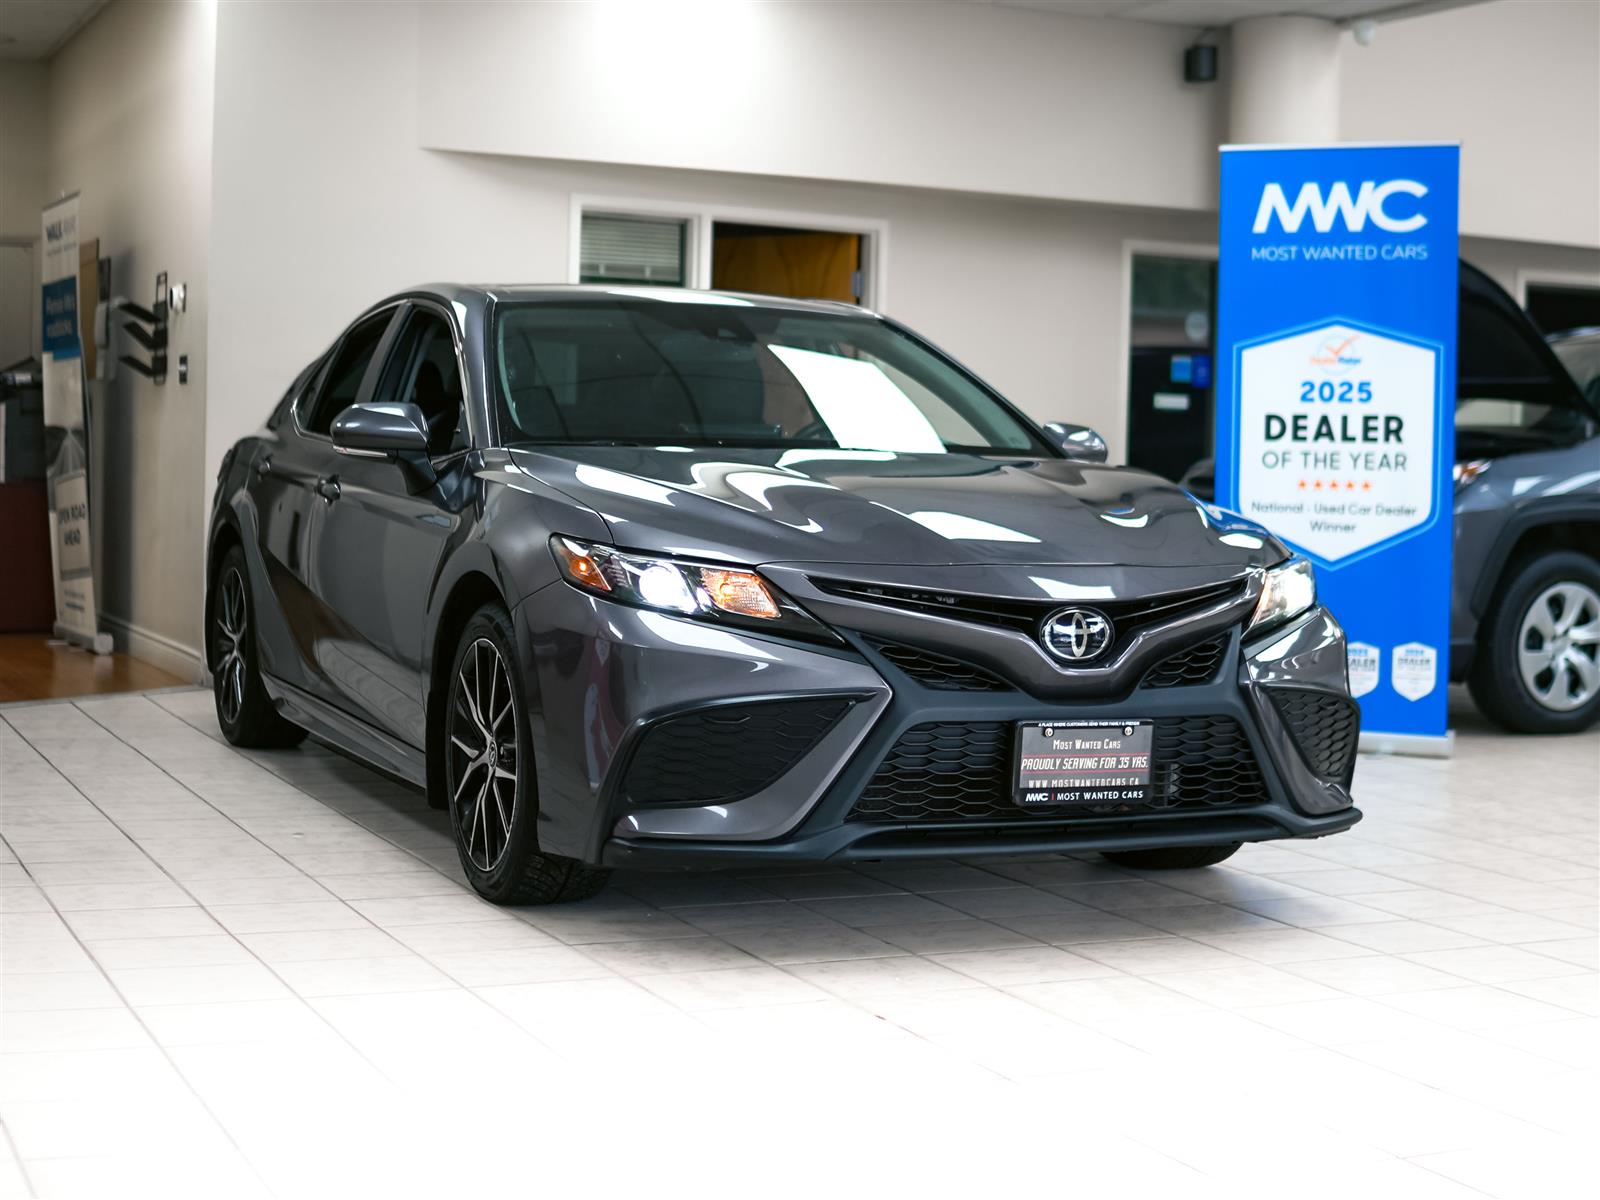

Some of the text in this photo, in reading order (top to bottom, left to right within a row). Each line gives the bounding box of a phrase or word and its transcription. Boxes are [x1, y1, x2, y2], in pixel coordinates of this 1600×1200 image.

[1252, 178, 1429, 234] MWC
[1251, 244, 1429, 262] MOST WANTED CARS
[1300, 381, 1373, 403] 2025
[1264, 414, 1404, 444] DEALER
[1262, 451, 1408, 472] OF THE YEAR
[1251, 501, 1304, 515] National
[1314, 503, 1345, 516] Used
[1348, 503, 1372, 516] Car
[1375, 503, 1417, 517] Dealer
[1310, 520, 1356, 534] Winner
[1021, 756, 1149, 770] PROUDLY SERVING FOR 35 YRS.
[1025, 790, 1144, 801] MWC MOST WANTED CARS
